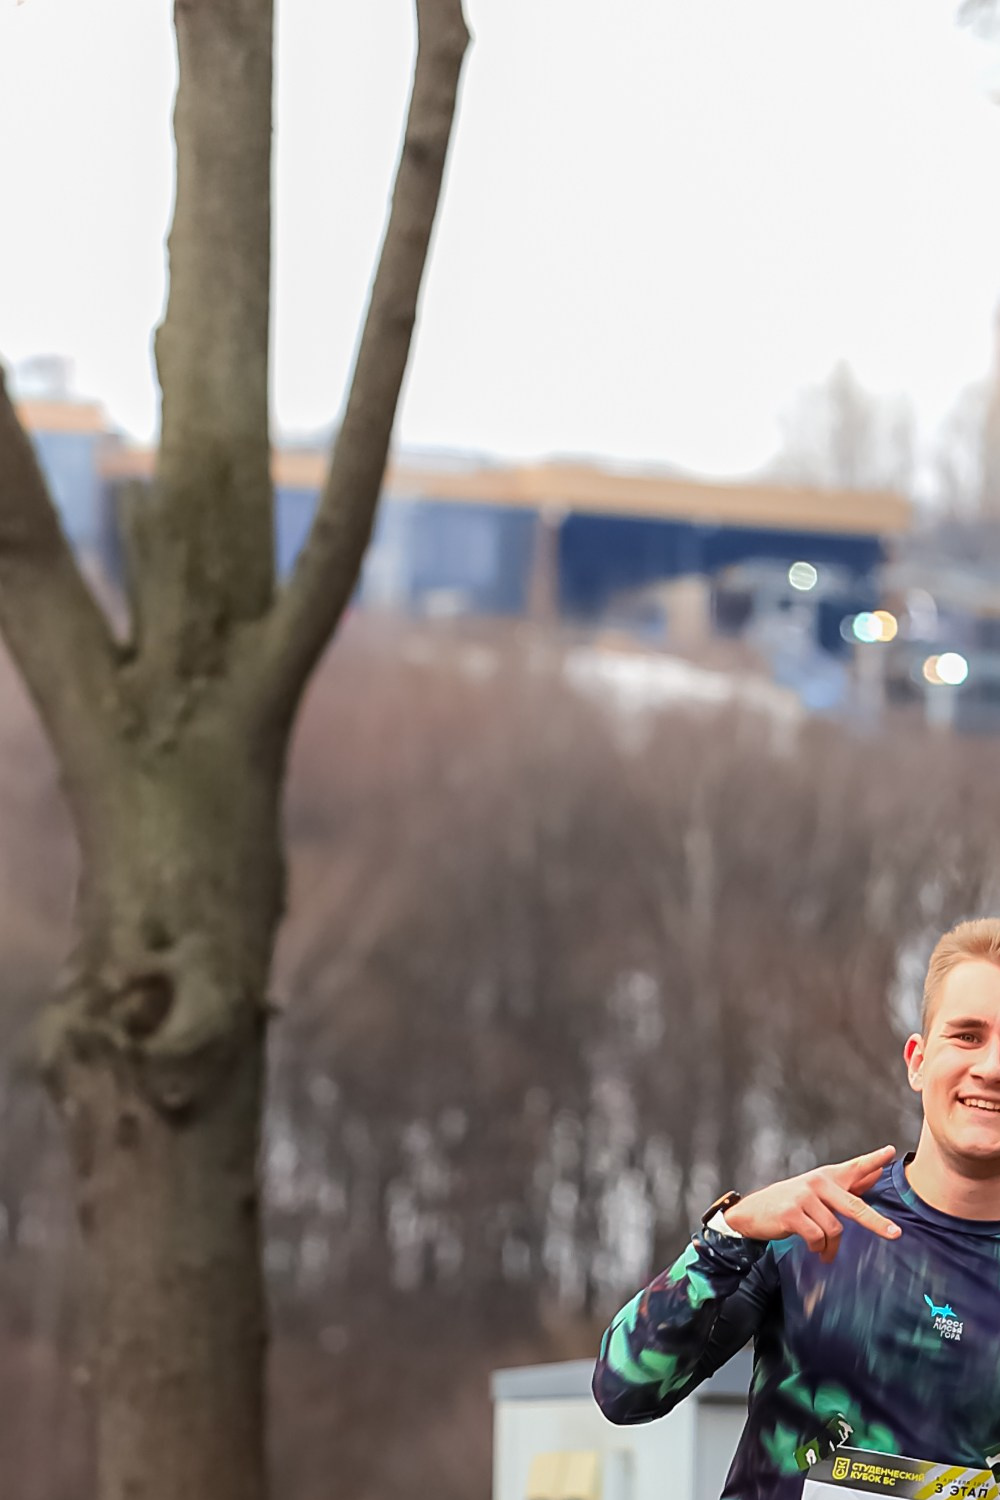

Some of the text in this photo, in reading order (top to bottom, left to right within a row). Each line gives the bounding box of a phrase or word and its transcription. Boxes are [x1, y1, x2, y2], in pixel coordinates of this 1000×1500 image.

[850, 1471, 896, 1486] КУБОК БС
[852, 1462, 925, 1482] СТУДЕНЧЕСКИЙ
[935, 1483, 988, 1498] 3 ЭТАП
